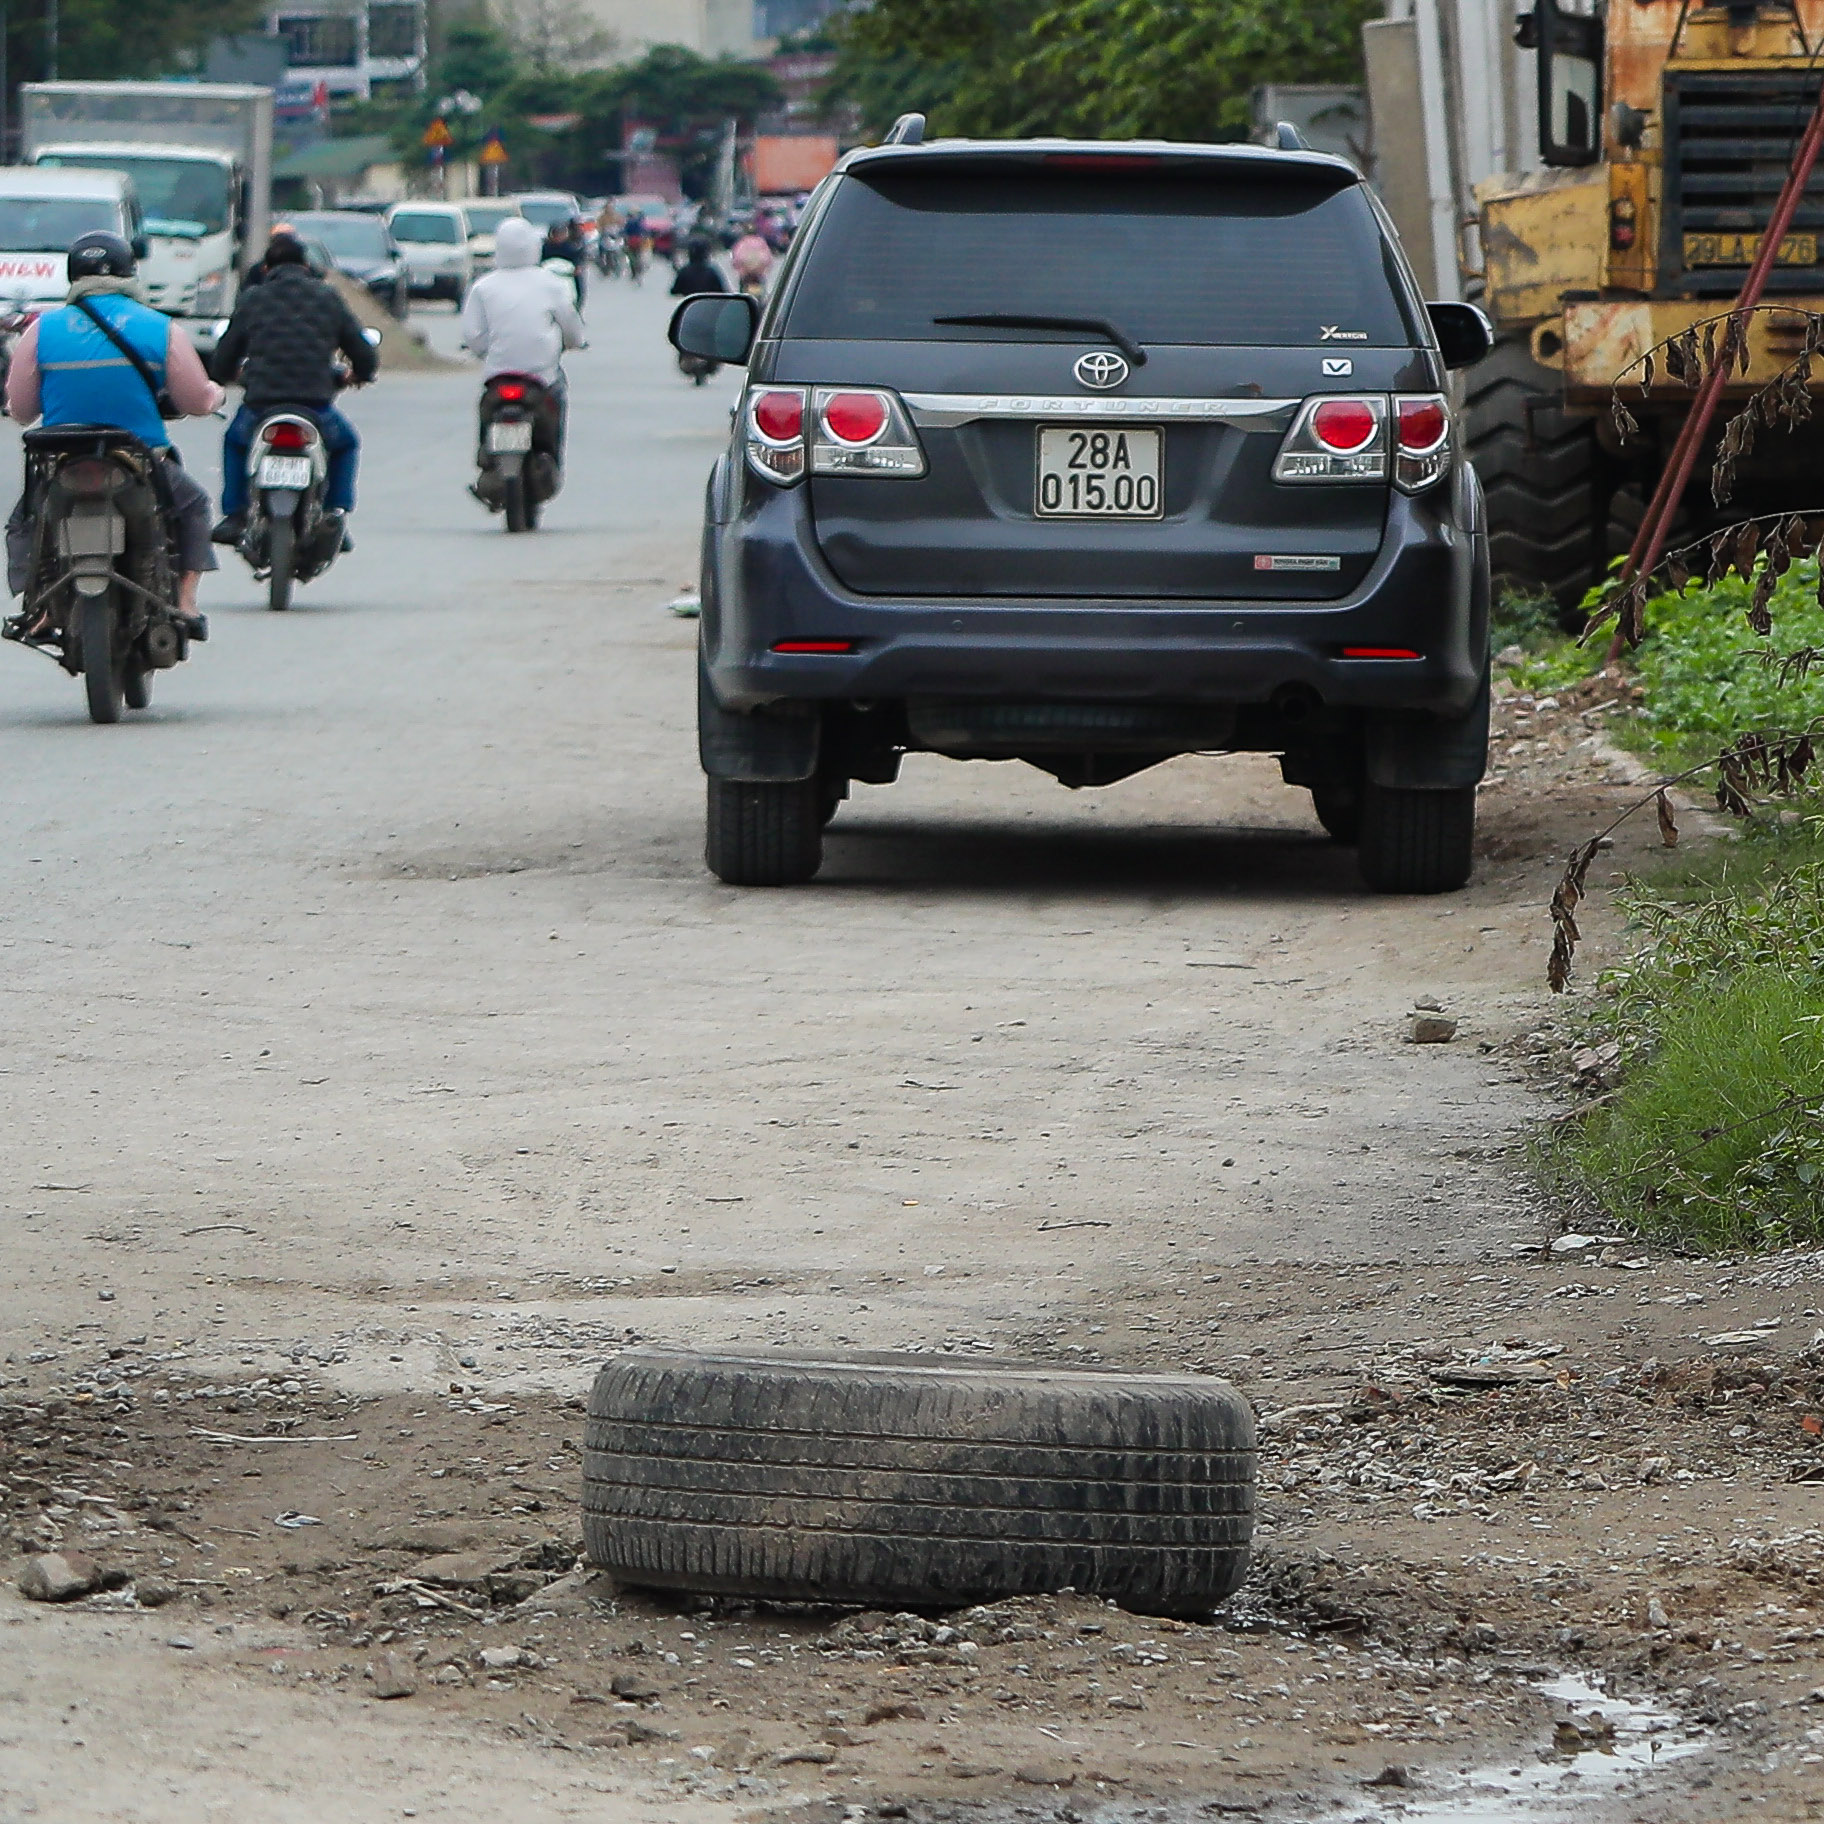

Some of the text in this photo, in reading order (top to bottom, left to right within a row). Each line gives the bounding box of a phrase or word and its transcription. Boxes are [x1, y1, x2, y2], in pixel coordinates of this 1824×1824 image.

[977, 398, 1228, 413] FORTUNER
[1067, 432, 1132, 470] 28A
[1041, 473, 1157, 511] 015.00
